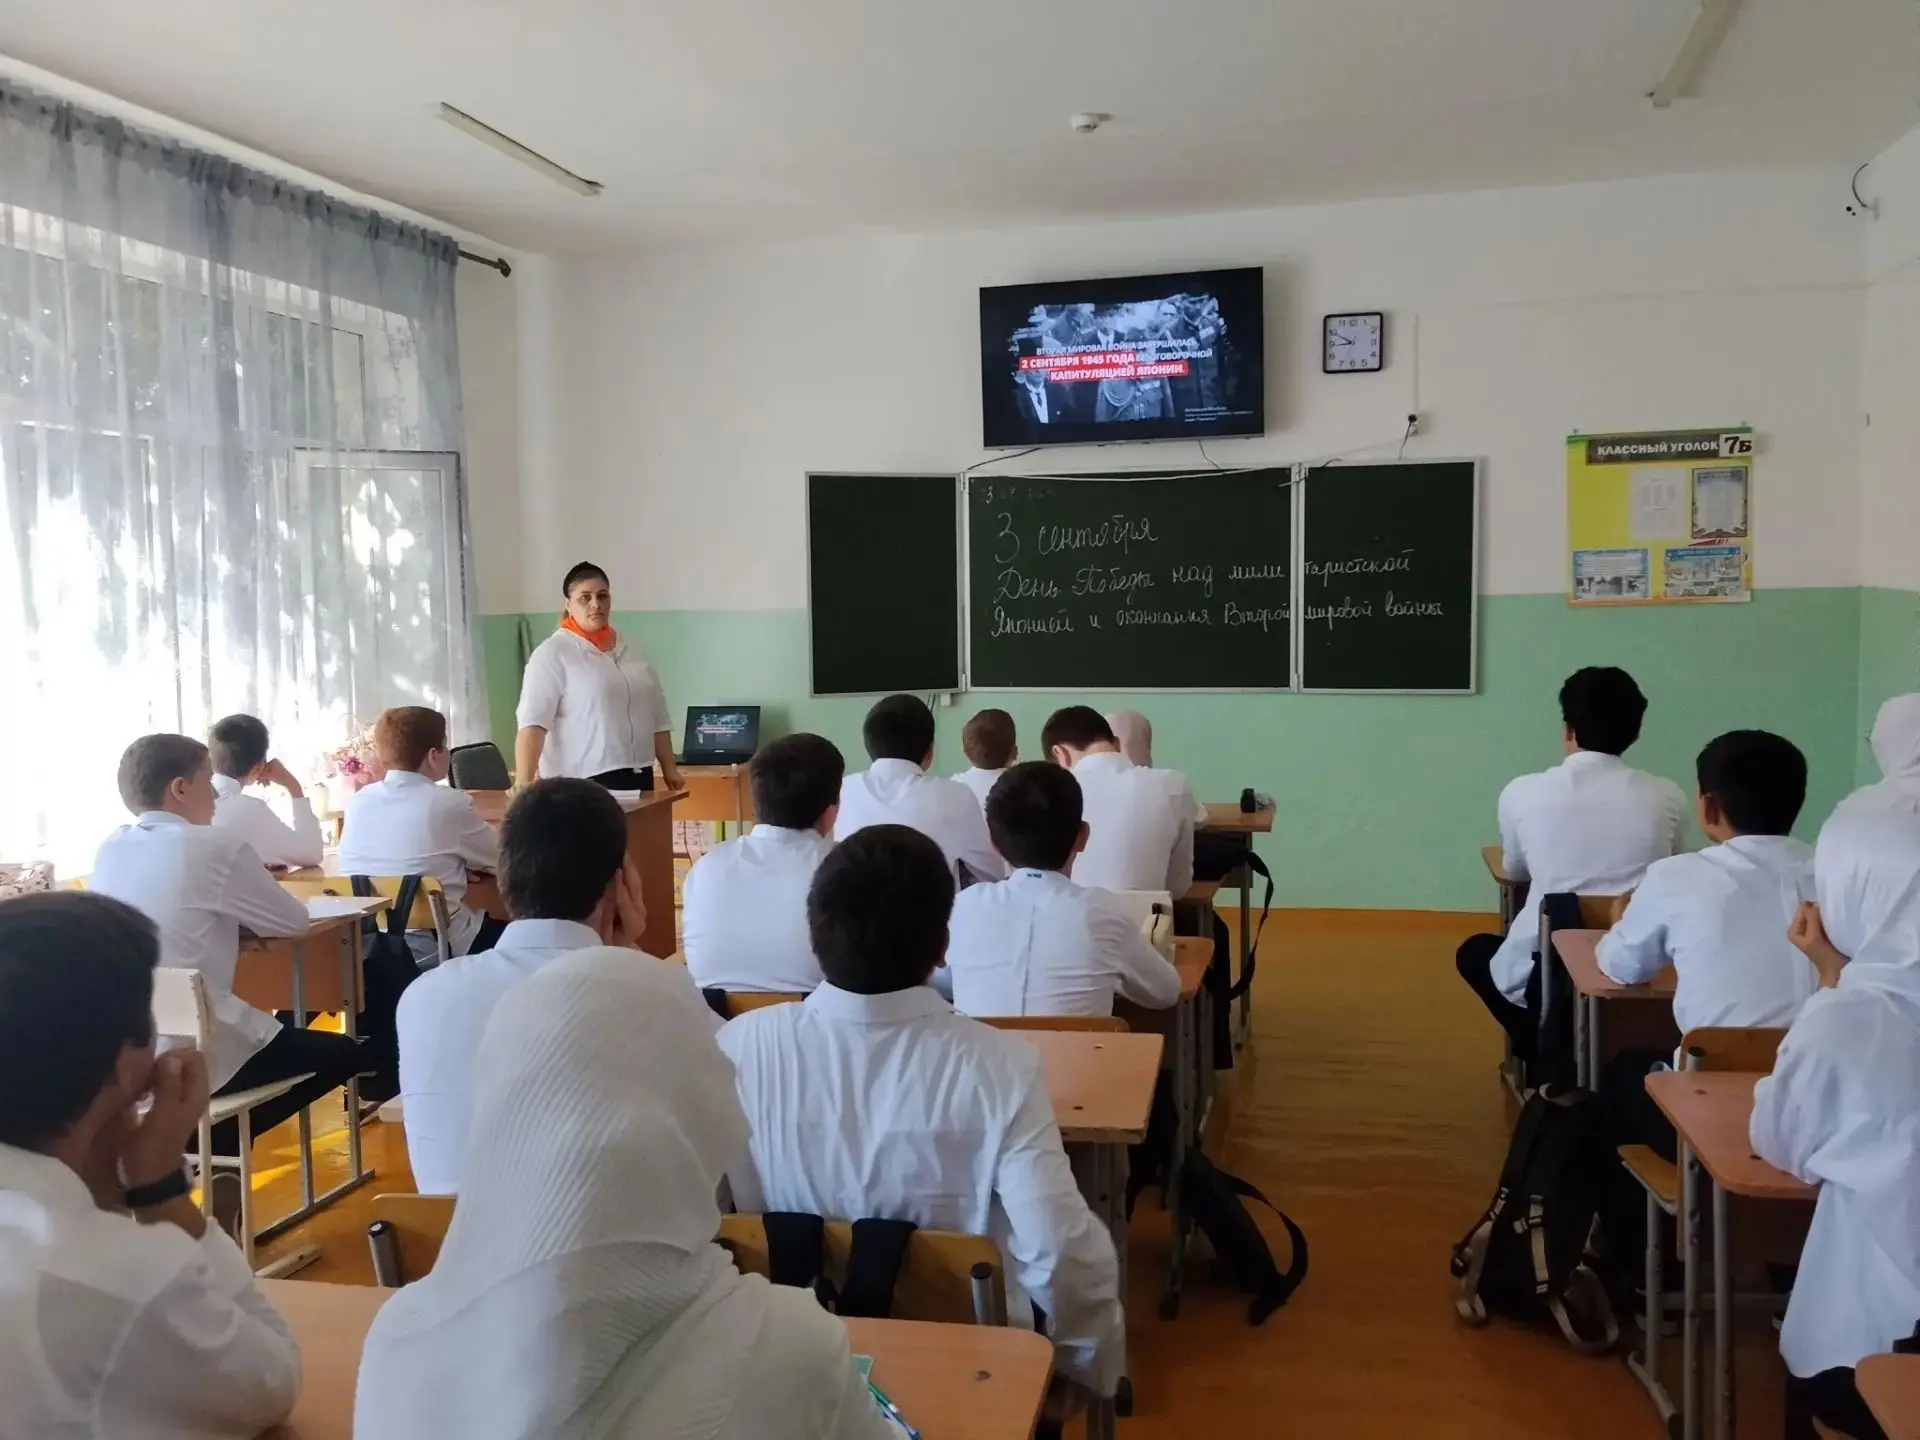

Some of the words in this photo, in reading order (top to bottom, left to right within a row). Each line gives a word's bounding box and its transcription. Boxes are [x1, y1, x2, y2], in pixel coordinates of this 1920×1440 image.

[1021, 359, 1029, 369] 2
[1030, 356, 1080, 368] СЕНТЯБРЯ
[1081, 354, 1104, 365] 1945
[1105, 352, 1135, 364] ГОДА
[1050, 365, 1135, 380] КАПИТУЛЯЦИЕЙ
[1136, 363, 1186, 376] ЯПОНИИ.
[1597, 441, 1668, 456] КЛАССНЫЙ
[1670, 440, 1720, 453] УГОЛОК
[994, 512, 1020, 564] 3
[1038, 514, 1158, 555] сентября
[993, 566, 1062, 605] День
[1172, 565, 1214, 598] над
[1384, 590, 1444, 617] войны
